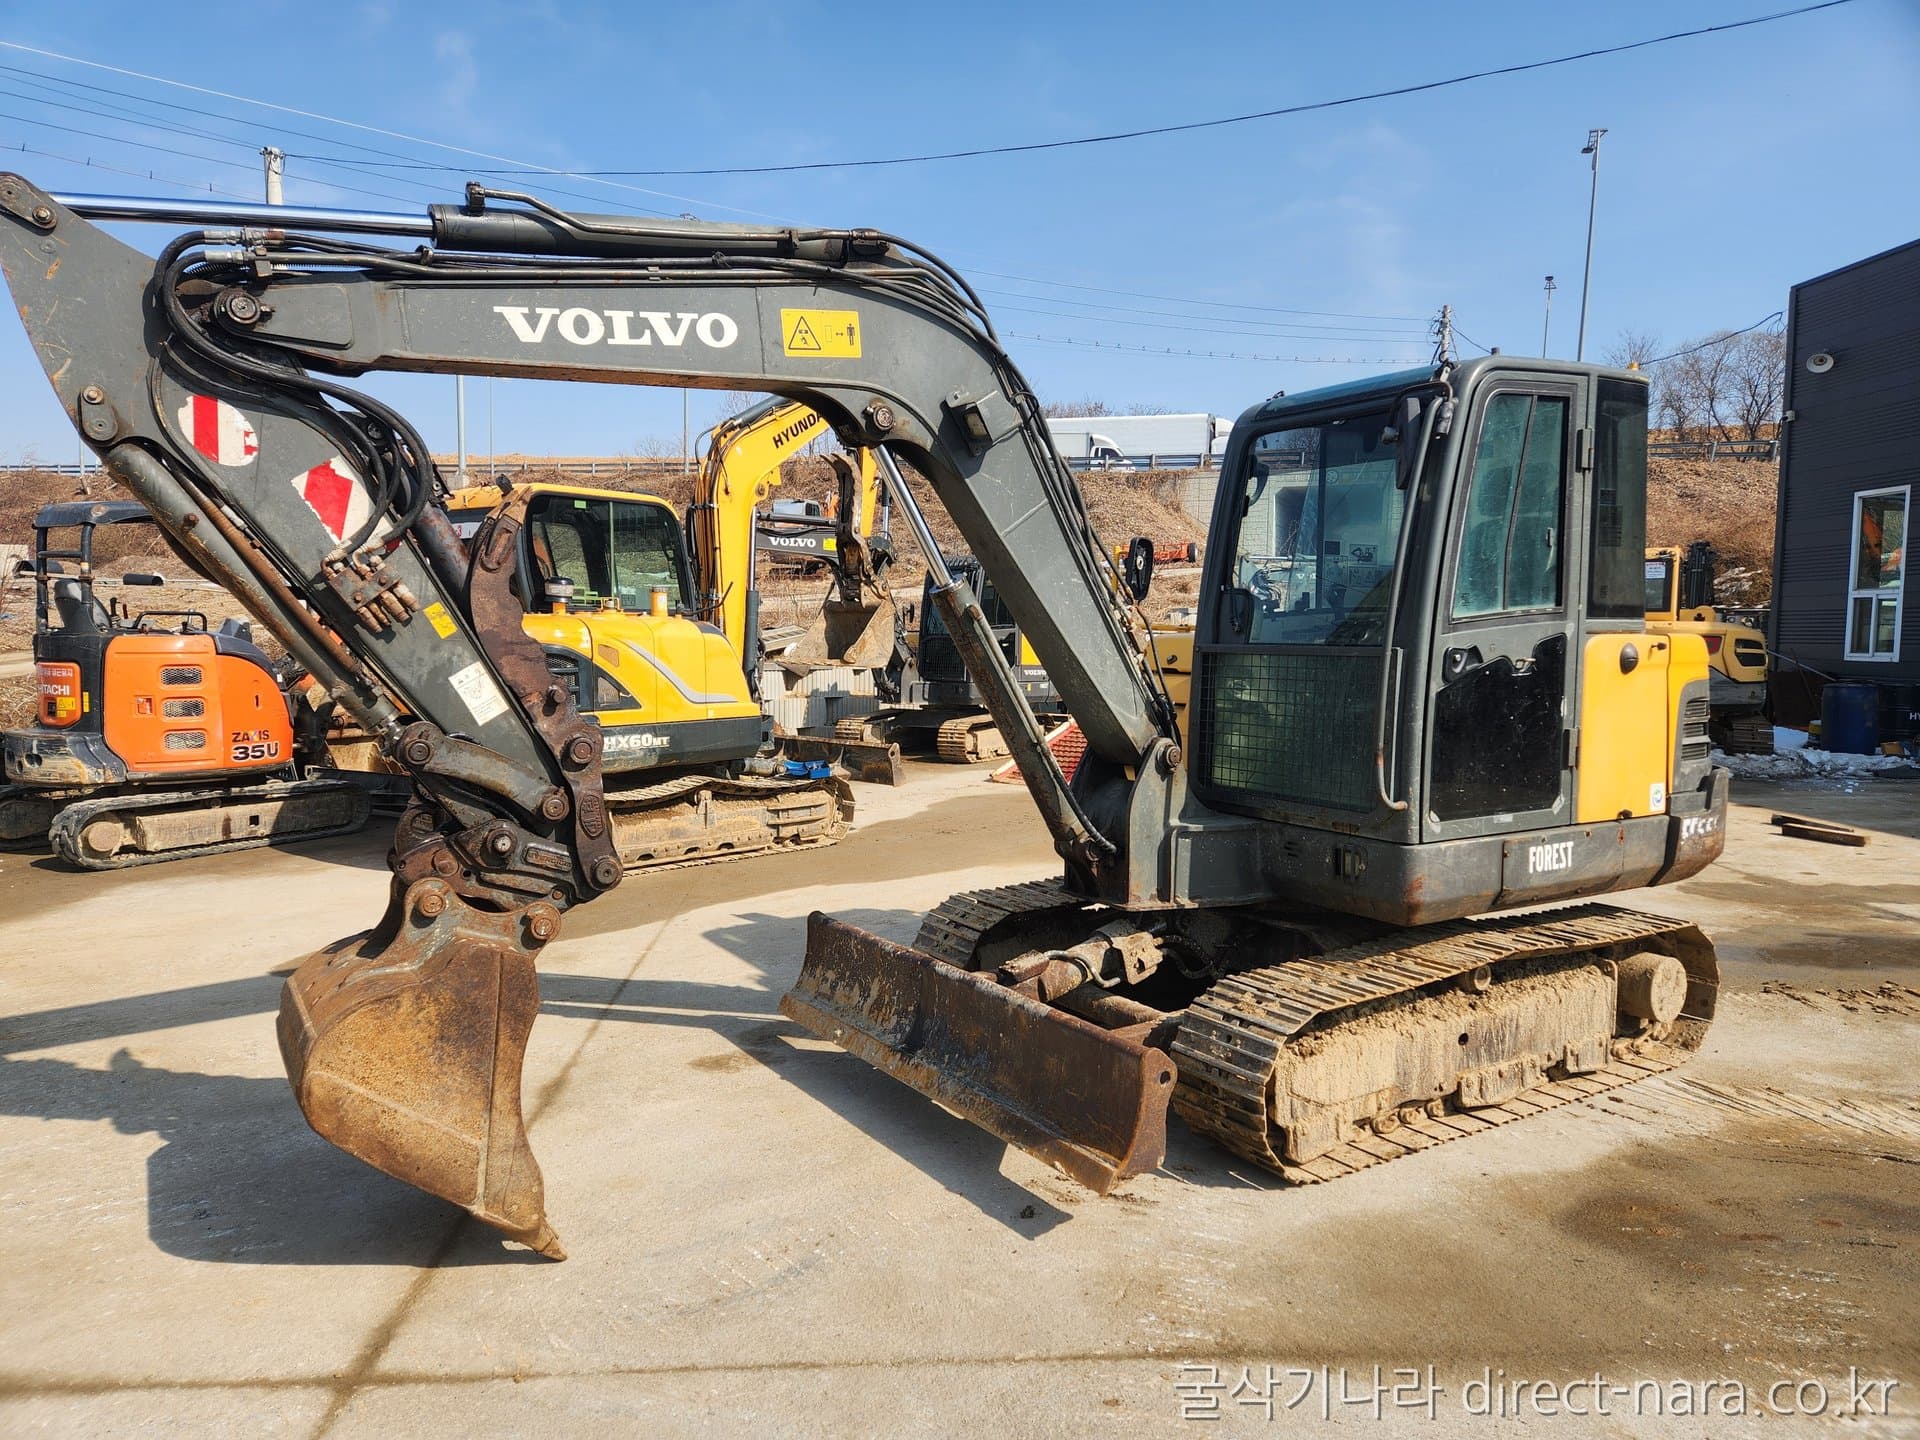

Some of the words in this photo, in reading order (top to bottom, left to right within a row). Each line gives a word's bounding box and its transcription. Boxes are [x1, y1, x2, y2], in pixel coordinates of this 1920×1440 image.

[493, 306, 738, 348] VOLVO
[768, 537, 816, 547] VOLVO
[231, 730, 270, 742] ZAXIS
[231, 741, 279, 762] 35U
[1528, 841, 1575, 874] FOREST
